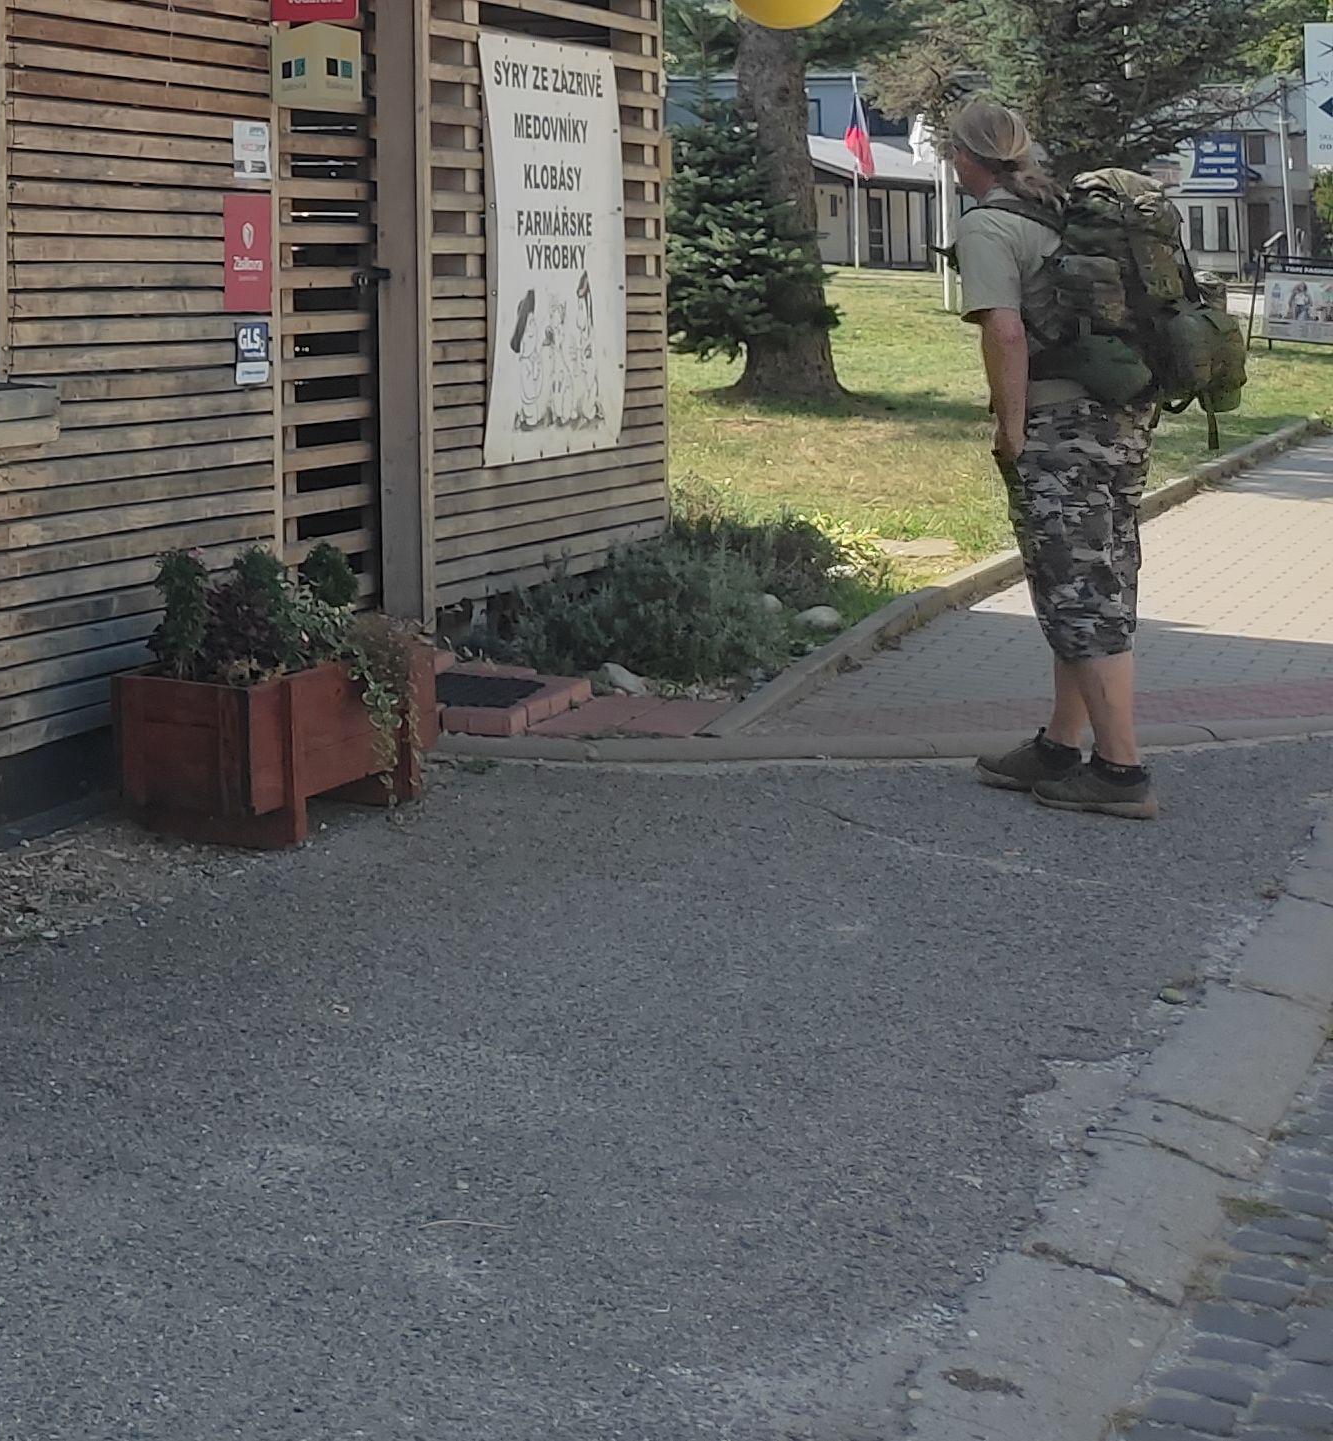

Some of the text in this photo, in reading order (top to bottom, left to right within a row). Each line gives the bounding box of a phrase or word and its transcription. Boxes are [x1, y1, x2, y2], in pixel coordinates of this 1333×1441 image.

[493, 55, 528, 89] SÝRY
[532, 66, 549, 91] ZE
[513, 112, 588, 144] MEDOVNÍKY
[524, 160, 581, 191] KLOBÁSY
[526, 239, 586, 270] VÝROBKY
[238, 327, 261, 350] GLS
